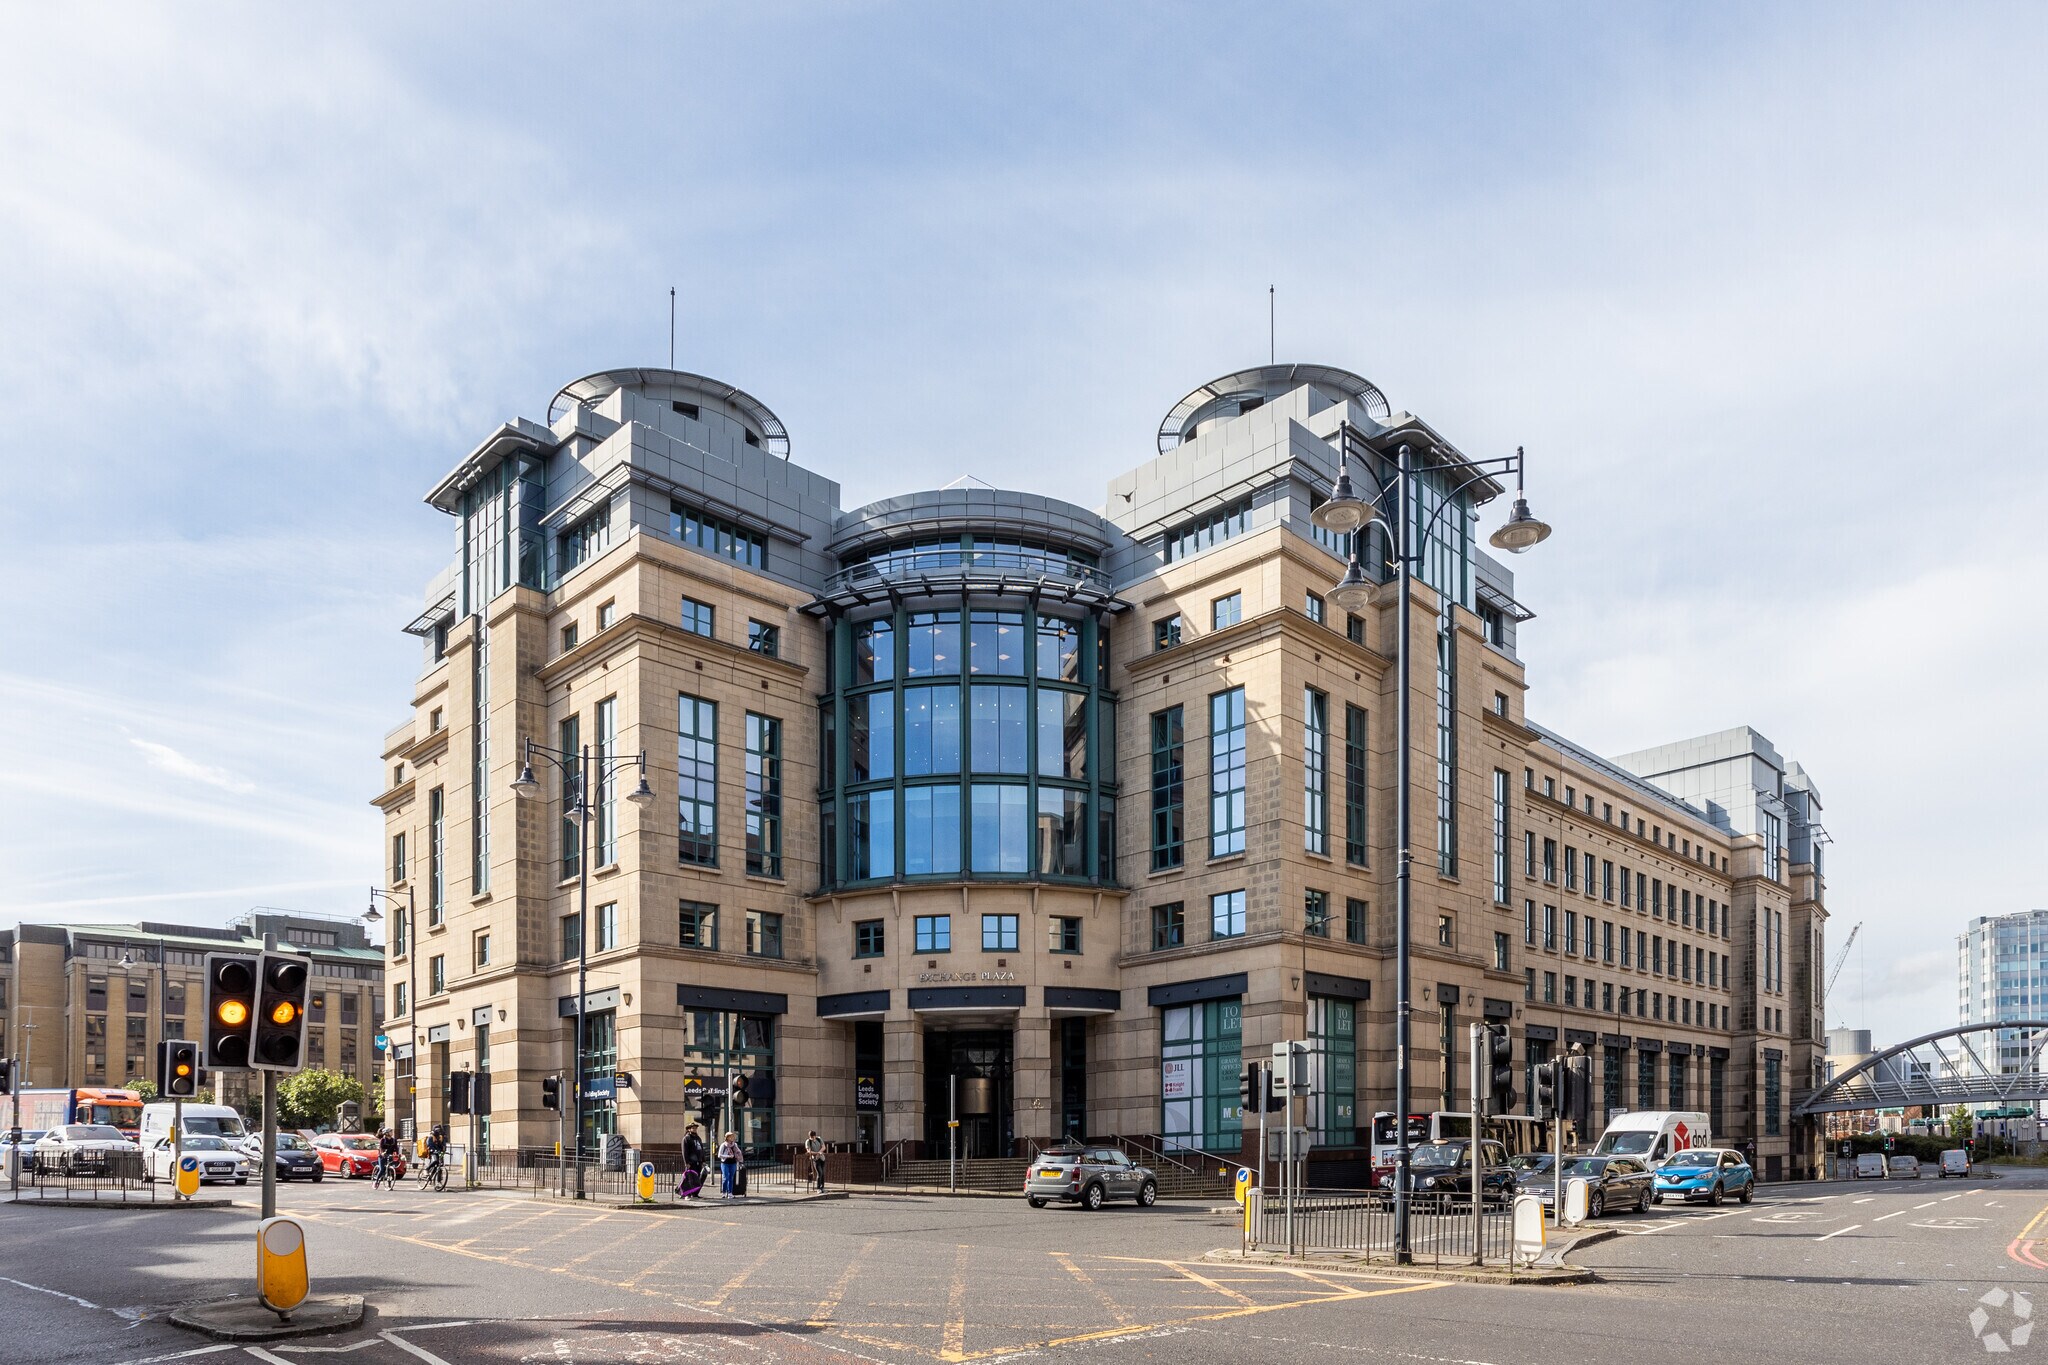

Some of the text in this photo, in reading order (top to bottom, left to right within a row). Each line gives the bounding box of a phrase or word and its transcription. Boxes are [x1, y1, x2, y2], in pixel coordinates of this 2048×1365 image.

[920, 971, 1015, 982] EXCHANGE PLAZA
[1223, 1006, 1238, 1017] TO
[1338, 1008, 1348, 1019] TO
[1338, 1020, 1351, 1030] LET
[1174, 1064, 1184, 1072] JLL
[1692, 1129, 1708, 1148] dpd
